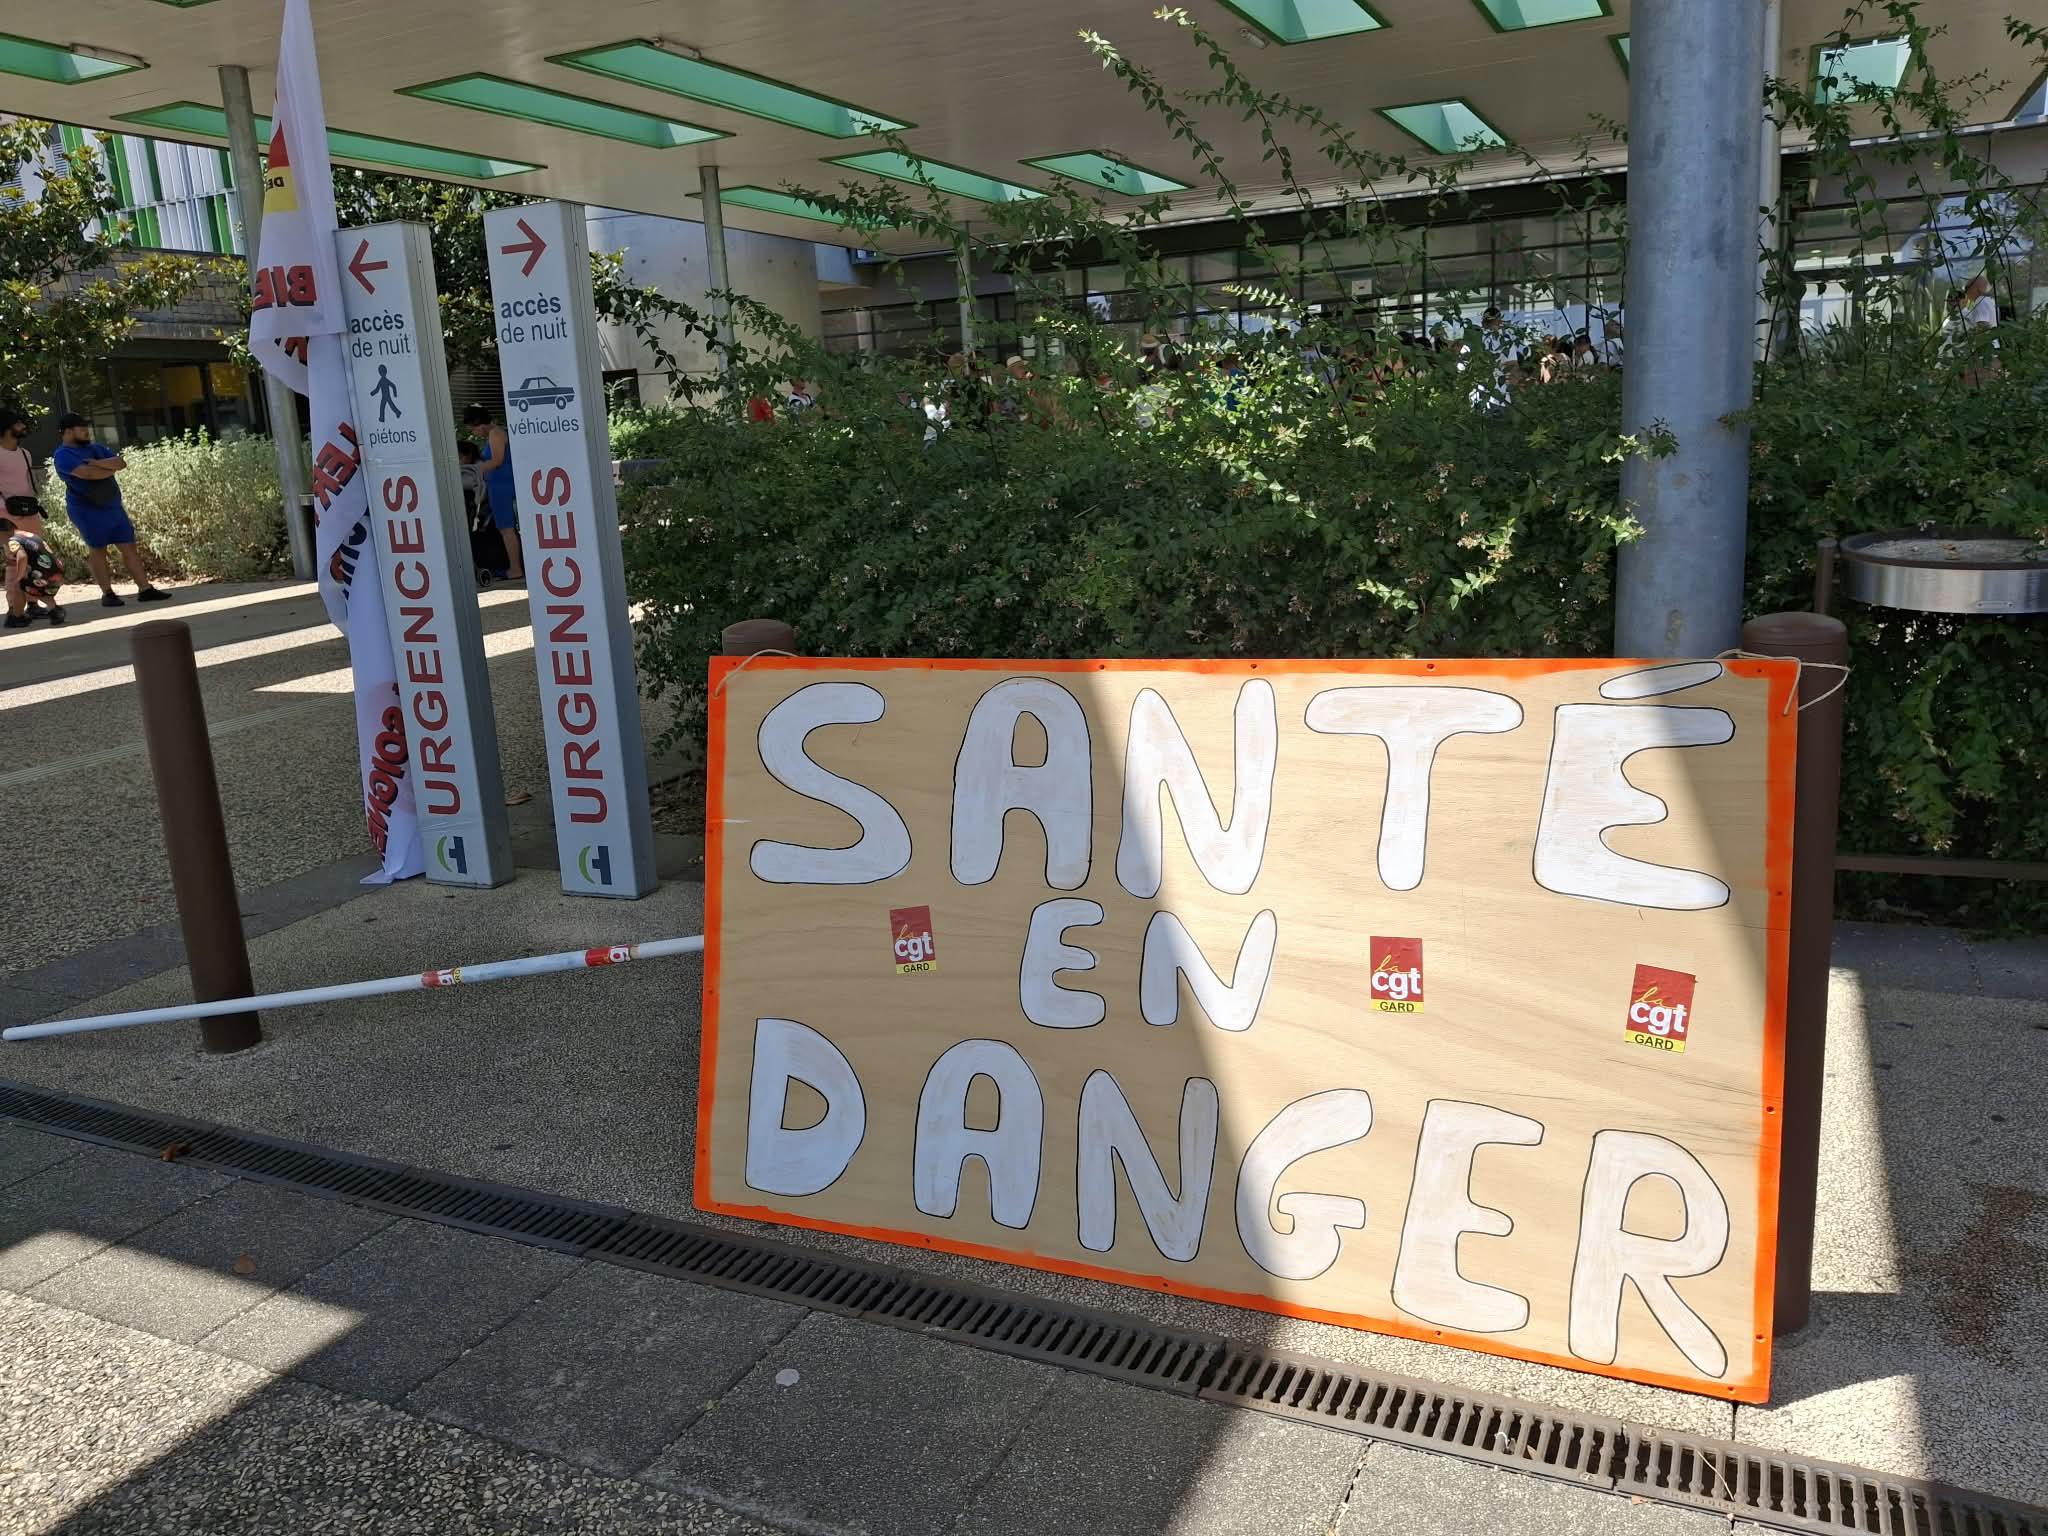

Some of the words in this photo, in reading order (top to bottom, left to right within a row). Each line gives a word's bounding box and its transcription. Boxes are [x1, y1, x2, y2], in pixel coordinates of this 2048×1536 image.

[501, 292, 562, 318] accès
[351, 309, 404, 334] accès
[501, 322, 525, 344] de
[532, 316, 568, 341] nuit
[352, 337, 373, 358] de
[379, 333, 411, 356] nuit
[369, 428, 417, 448] piétons
[509, 415, 580, 436] véhicules
[382, 475, 461, 815] URGENCES
[531, 467, 608, 824] URGENCES
[750, 661, 1736, 911] SANTÉ
[895, 931, 933, 961] cgt
[903, 962, 930, 973] GARD
[1019, 897, 1279, 1033] EN
[1371, 967, 1422, 1000] cgt
[1380, 1001, 1415, 1012] GARD
[1630, 1003, 1687, 1035] cgt
[1634, 1033, 1674, 1050] GARD
[745, 1017, 1730, 1380] DANGER
